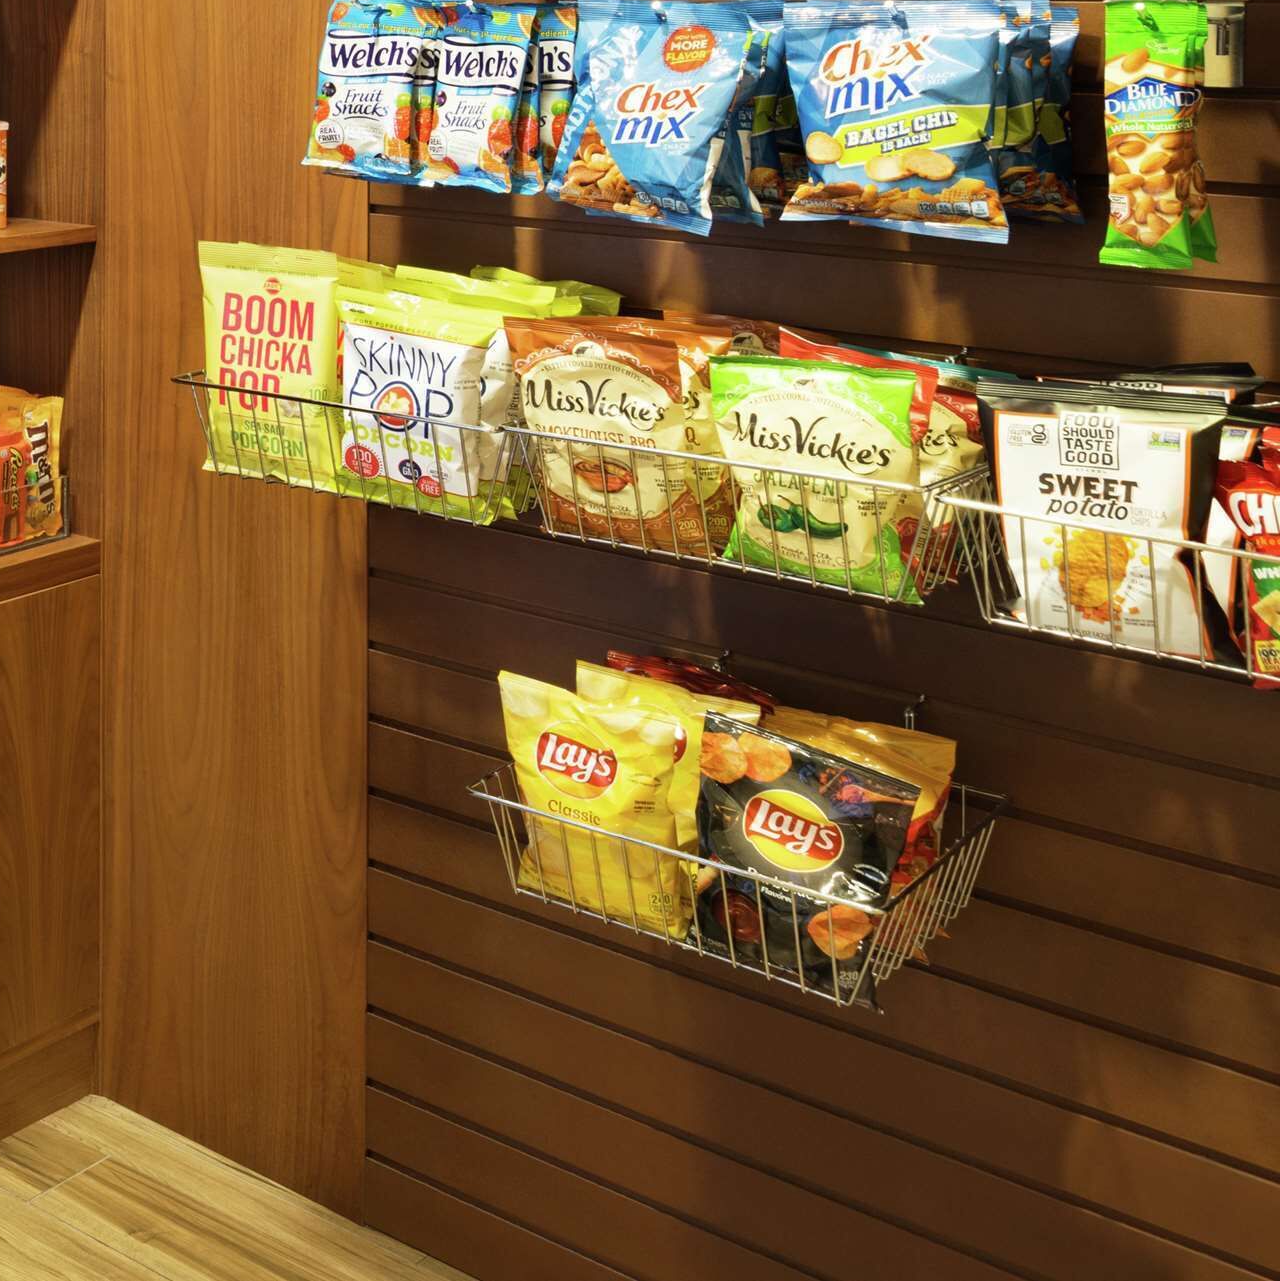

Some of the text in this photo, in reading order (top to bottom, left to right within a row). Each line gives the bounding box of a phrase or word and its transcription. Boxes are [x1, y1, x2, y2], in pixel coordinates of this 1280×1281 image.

[329, 41, 420, 67] Welch's
[665, 49, 709, 61] FLAVOR
[670, 37, 707, 51] MORE
[443, 48, 518, 79] Welch's
[821, 33, 934, 83] Chex
[344, 88, 382, 104] Fruit
[617, 82, 704, 113] Chex
[828, 73, 917, 116] mix
[1104, 93, 1197, 113] DIAMOND
[1126, 81, 1167, 100] BLUE
[333, 102, 388, 115] Snacks
[455, 100, 486, 115] Fruit
[441, 114, 486, 130] Snacks
[613, 110, 692, 147] mix
[845, 122, 910, 148] BAGEL
[1110, 122, 1141, 134] Whole
[881, 132, 932, 153] IS BACK!
[223, 293, 314, 342] BOOM
[221, 333, 312, 375] CHICKA
[352, 336, 457, 384] SKINNY
[219, 368, 280, 412] POP
[526, 378, 666, 426] Miss Vickie's
[349, 369, 453, 439] POP
[1063, 413, 1114, 428] FOOD
[1063, 426, 1115, 442] SHOULD
[231, 431, 303, 460] POPCORN
[732, 413, 890, 473] Miss Vickie's
[1064, 437, 1113, 451] TASTE
[1065, 449, 1113, 466] GOOD
[1039, 473, 1137, 503] SWEET
[1047, 494, 1129, 521] potato
[538, 734, 614, 784] Lay's
[547, 798, 600, 826] Classic
[748, 800, 838, 857] Lay's
